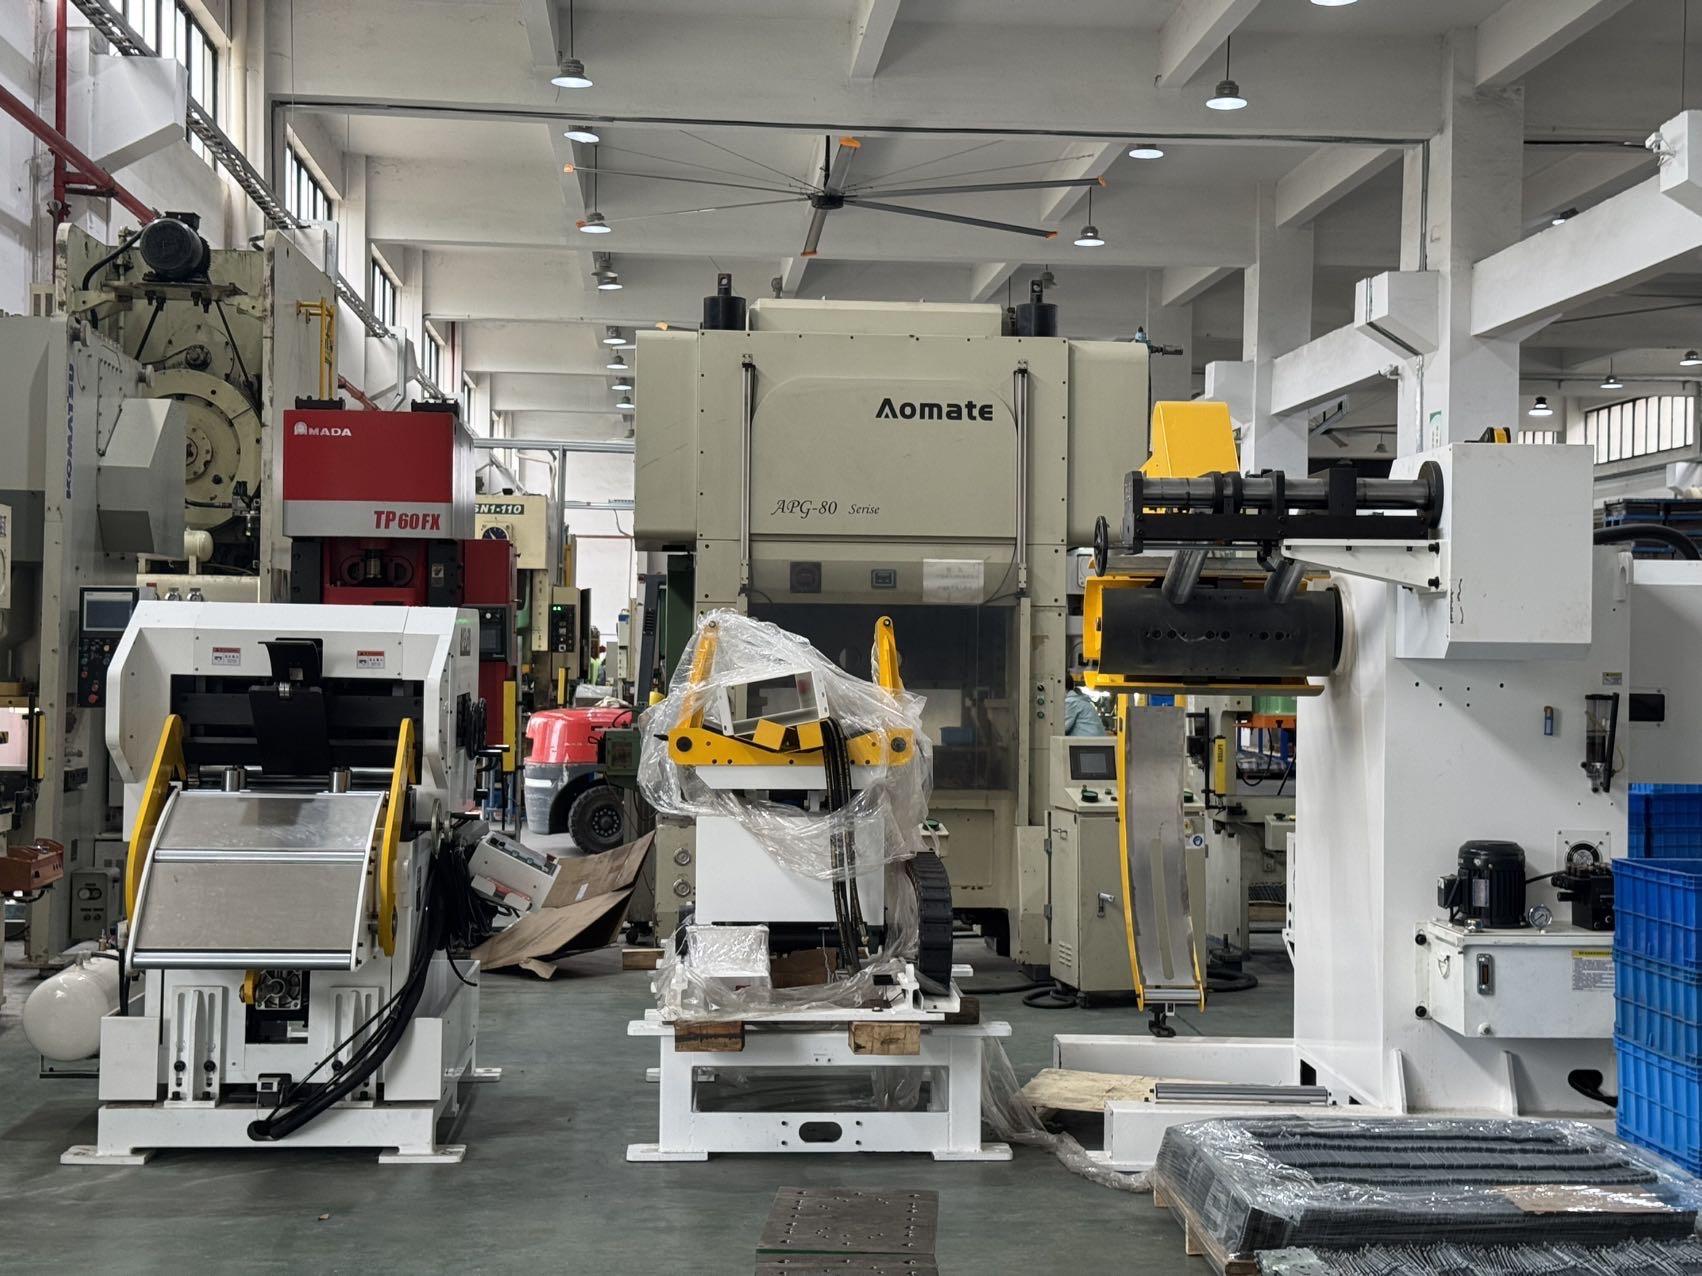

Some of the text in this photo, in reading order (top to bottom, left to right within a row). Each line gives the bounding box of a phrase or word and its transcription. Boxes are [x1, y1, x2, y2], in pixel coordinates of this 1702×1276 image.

[875, 398, 993, 421] Aomate
[66, 364, 75, 499] KOMATSU
[294, 421, 352, 436] AMADA
[771, 499, 880, 519] APG-80 Serise
[374, 511, 440, 531] TP60FX
